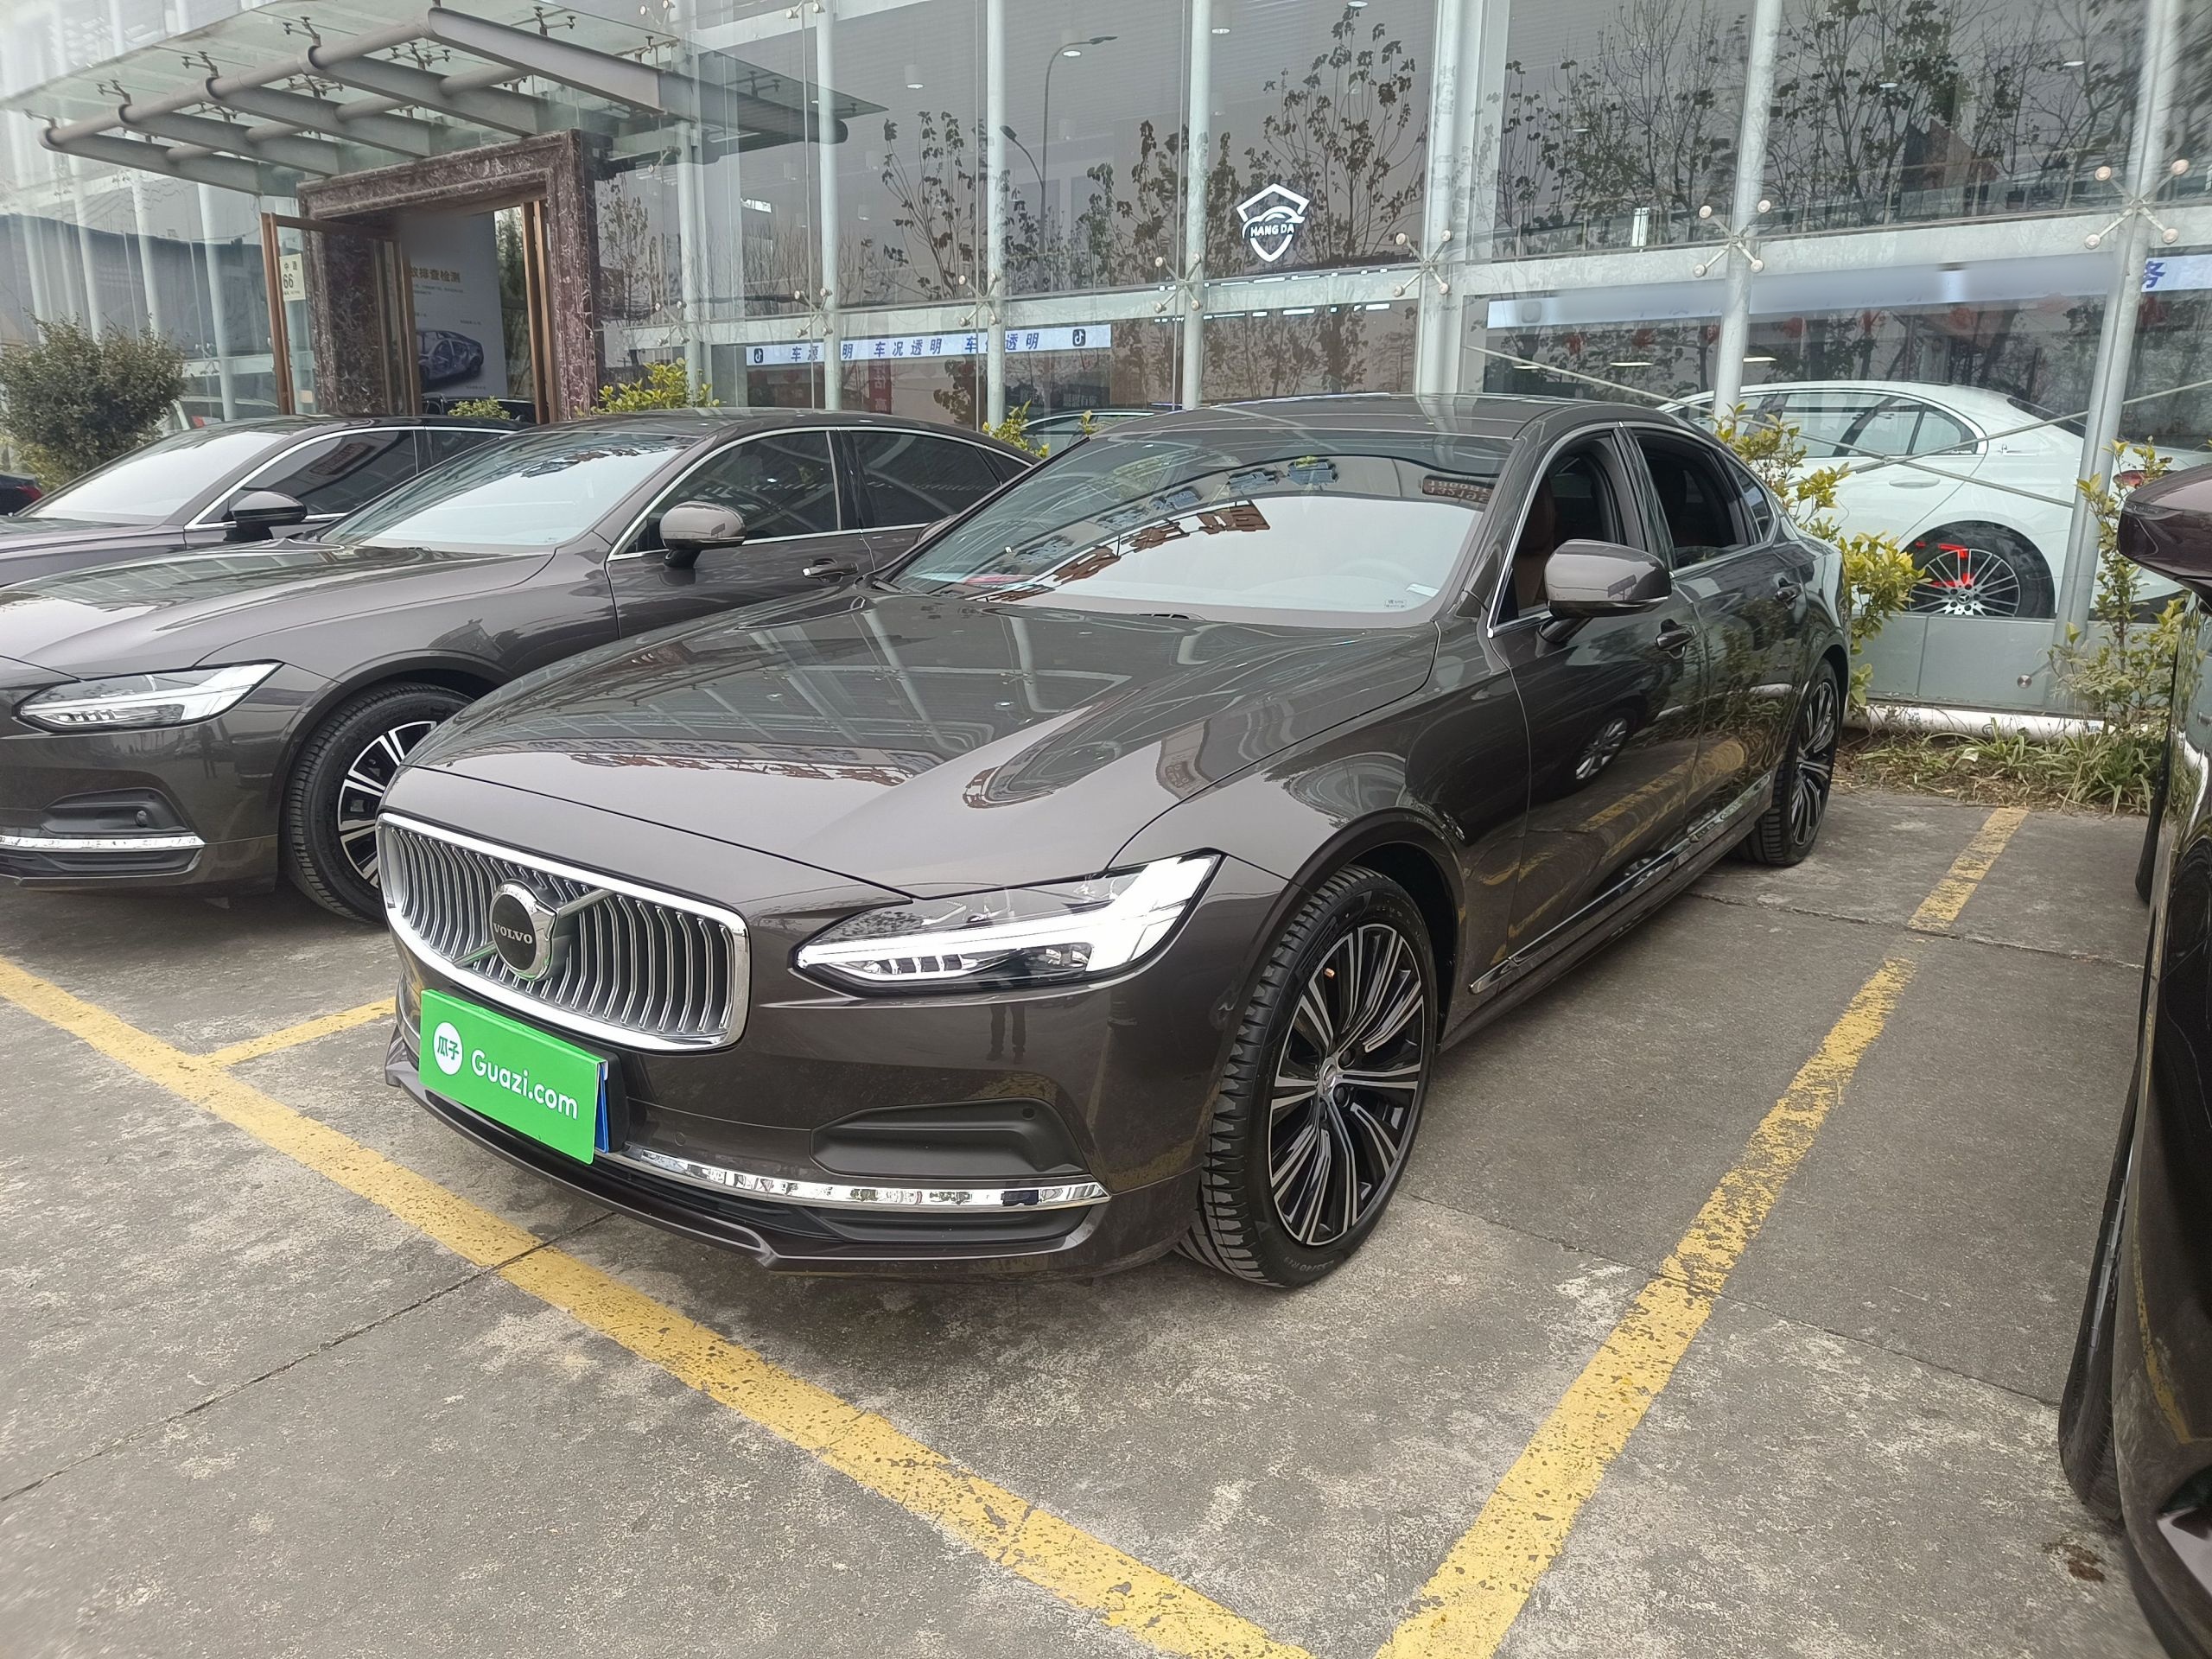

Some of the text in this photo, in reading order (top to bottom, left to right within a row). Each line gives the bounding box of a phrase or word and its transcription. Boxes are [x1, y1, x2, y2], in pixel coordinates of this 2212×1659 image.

[1250, 223, 1295, 237] HANG DA
[283, 273, 294, 289] 66
[874, 338, 943, 358] 车况透明
[964, 332, 1039, 353] 车透明
[493, 923, 533, 944] VOLVO
[437, 1035, 460, 1060] 瓜子
[470, 1048, 578, 1120] Guazi.com
